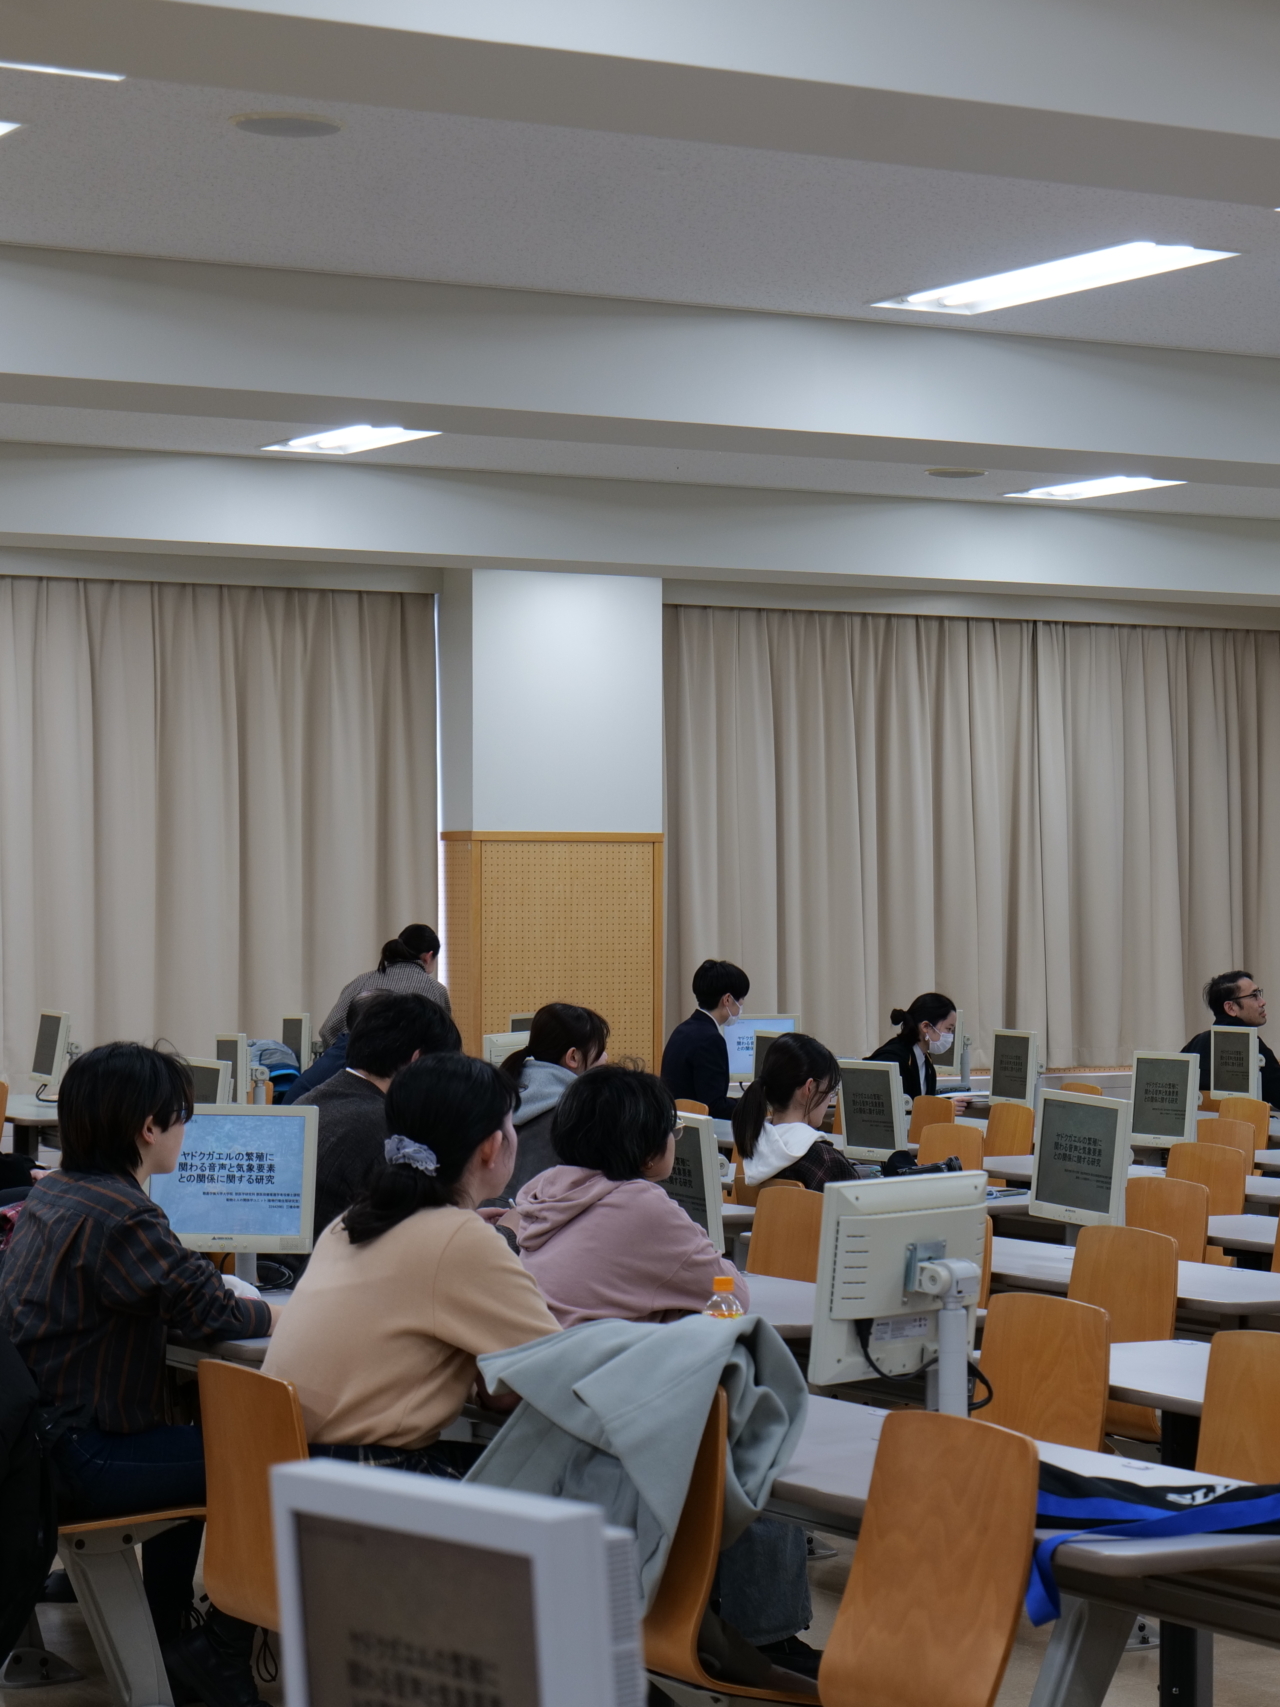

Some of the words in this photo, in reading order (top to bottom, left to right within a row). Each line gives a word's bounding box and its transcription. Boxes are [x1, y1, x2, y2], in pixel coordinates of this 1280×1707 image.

[181, 1151, 274, 1161] ヤドクガエルの繁殖に
[178, 1162, 276, 1173] 関わる音声と気象要素
[178, 1174, 275, 1185] との関係に関する研究
